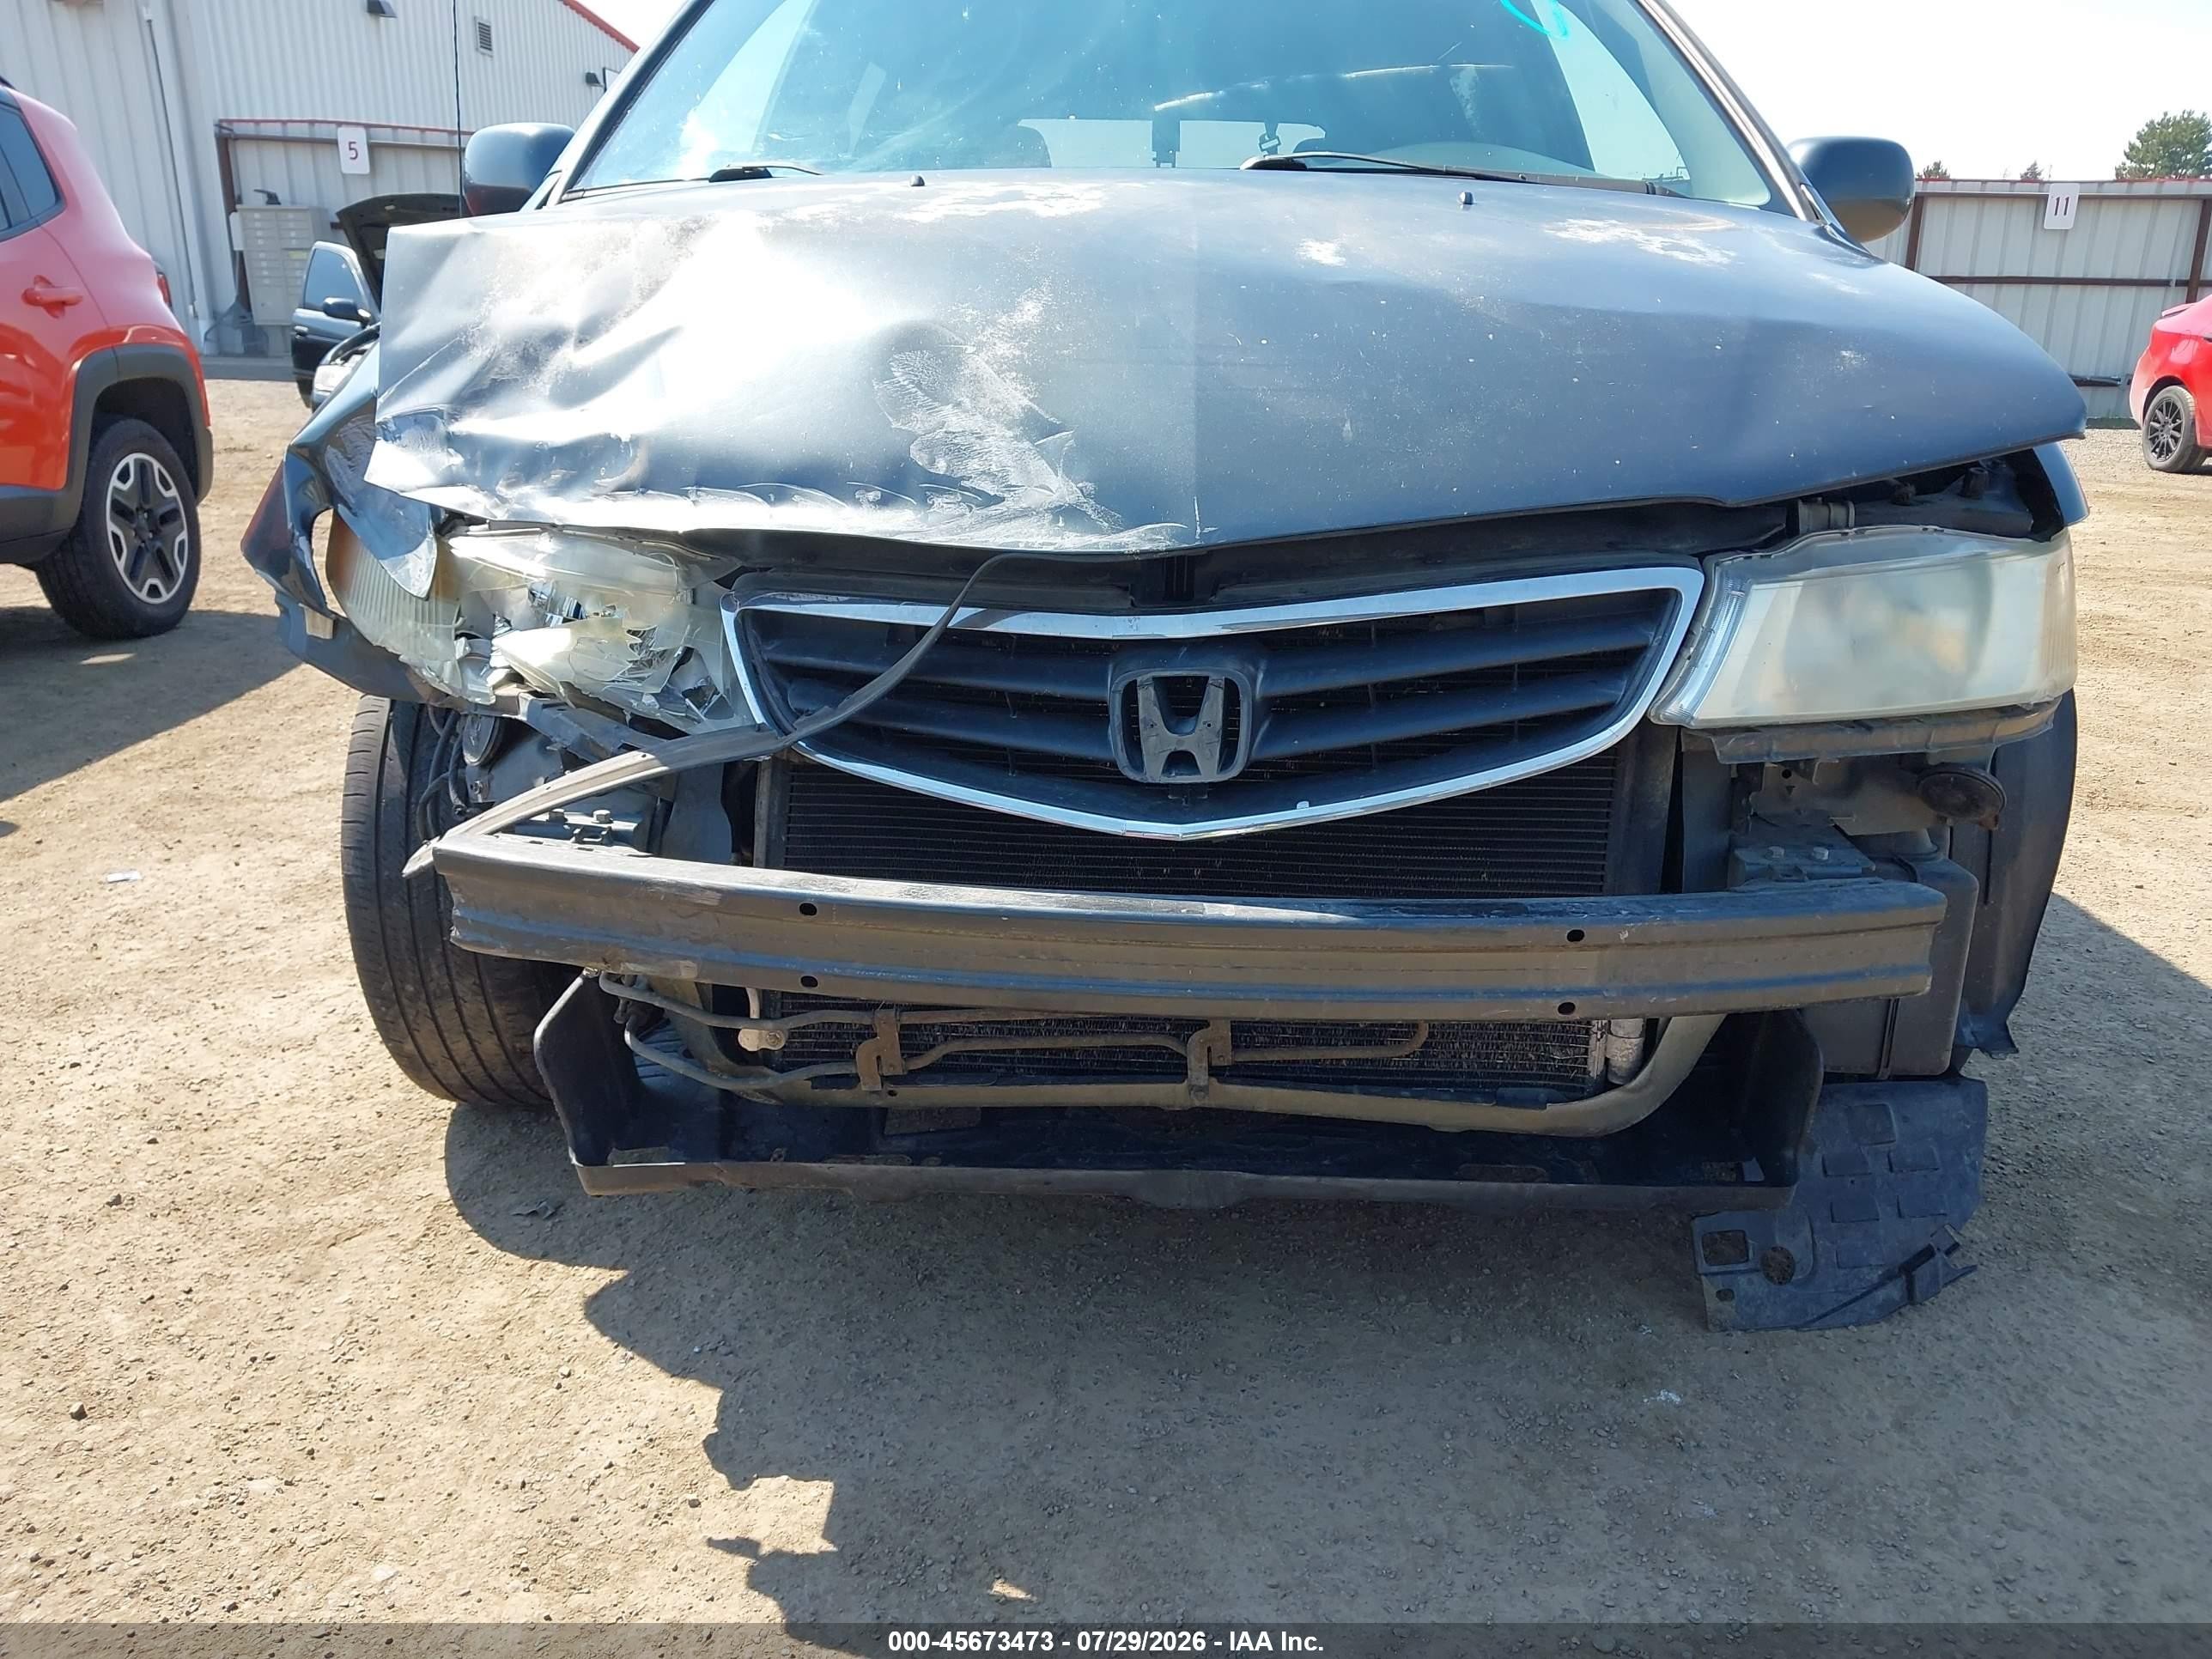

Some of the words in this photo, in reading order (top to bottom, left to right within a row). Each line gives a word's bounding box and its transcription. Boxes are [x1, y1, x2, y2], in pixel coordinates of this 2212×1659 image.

[348, 141, 359, 161] 5
[2054, 196, 2070, 216] 11
[1135, 675, 1225, 783] H
